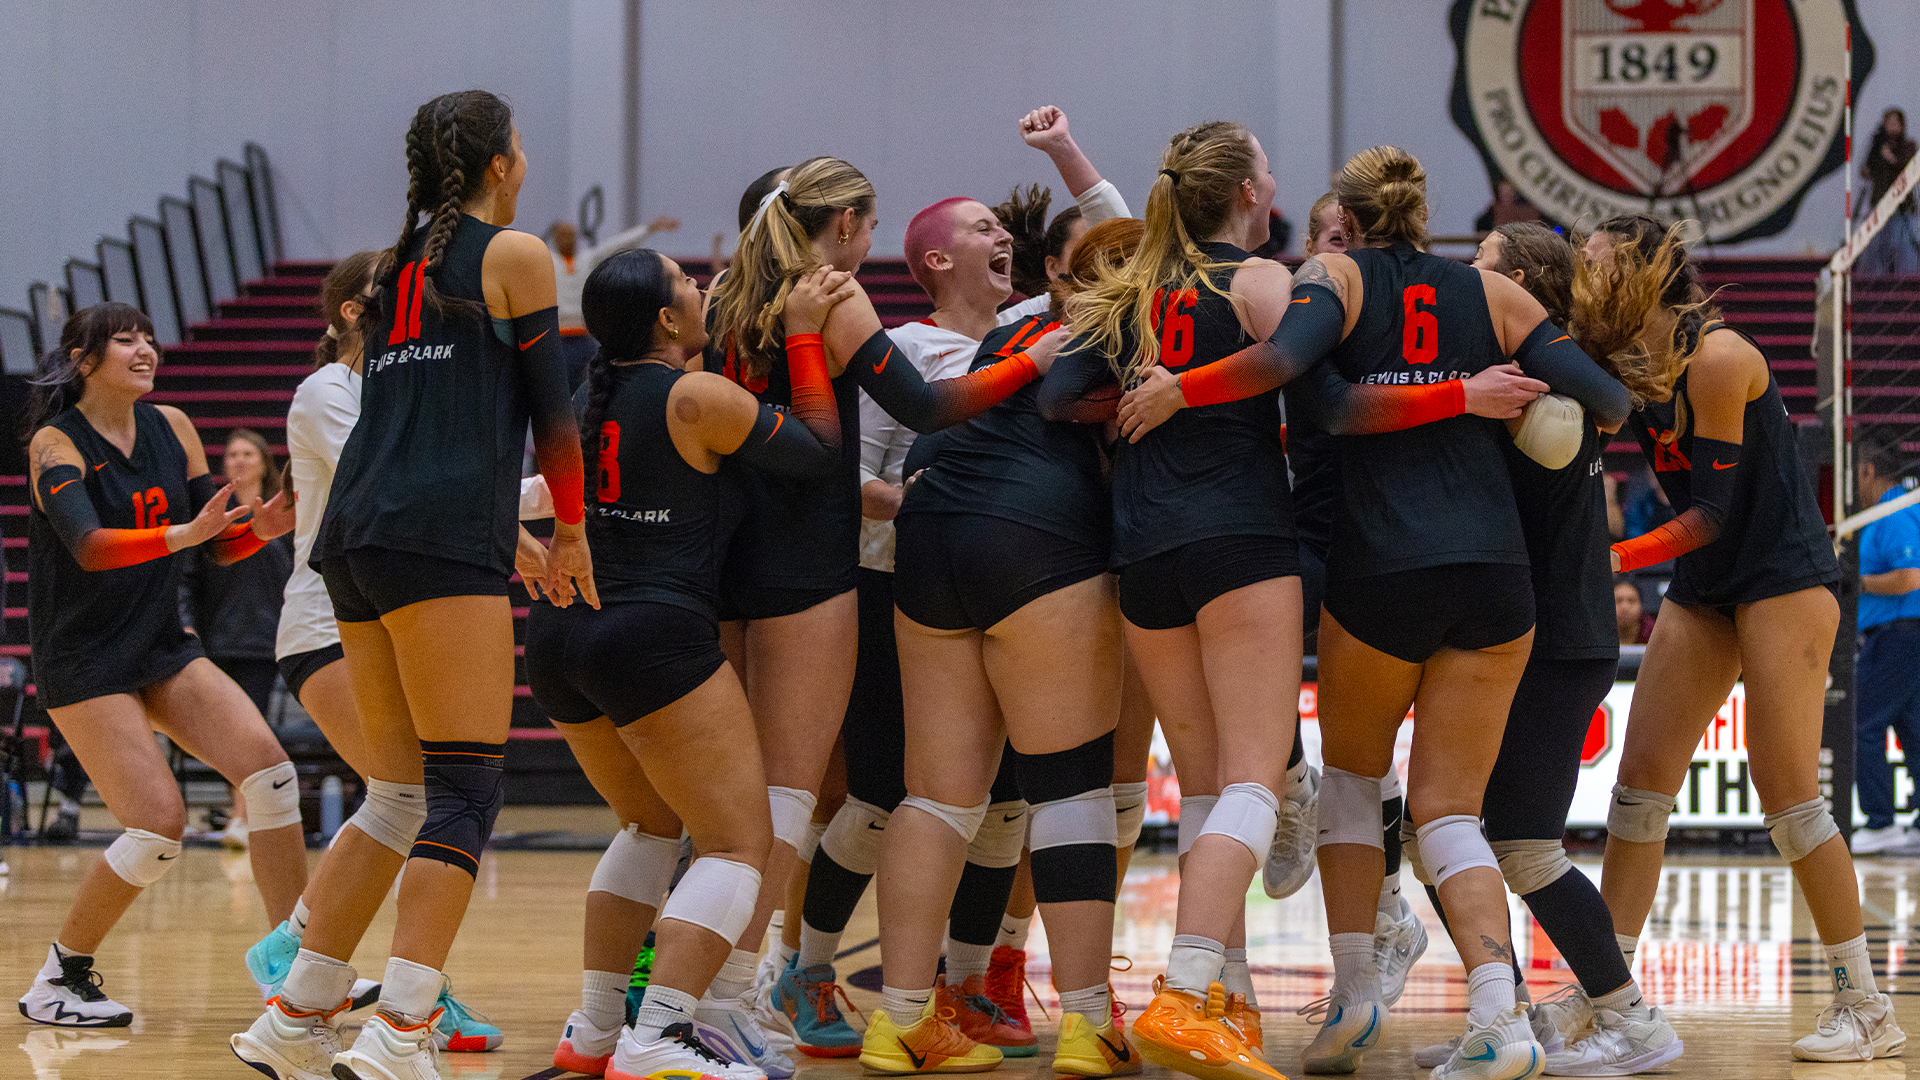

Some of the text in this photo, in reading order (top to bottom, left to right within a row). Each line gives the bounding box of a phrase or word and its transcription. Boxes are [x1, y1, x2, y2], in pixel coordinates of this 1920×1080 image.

[1592, 43, 1719, 83] 1849
[1485, 87, 1526, 151] PRO
[387, 256, 429, 346] 11
[1402, 283, 1439, 365] 6
[1413, 370, 1425, 384] &
[132, 486, 170, 530] 12
